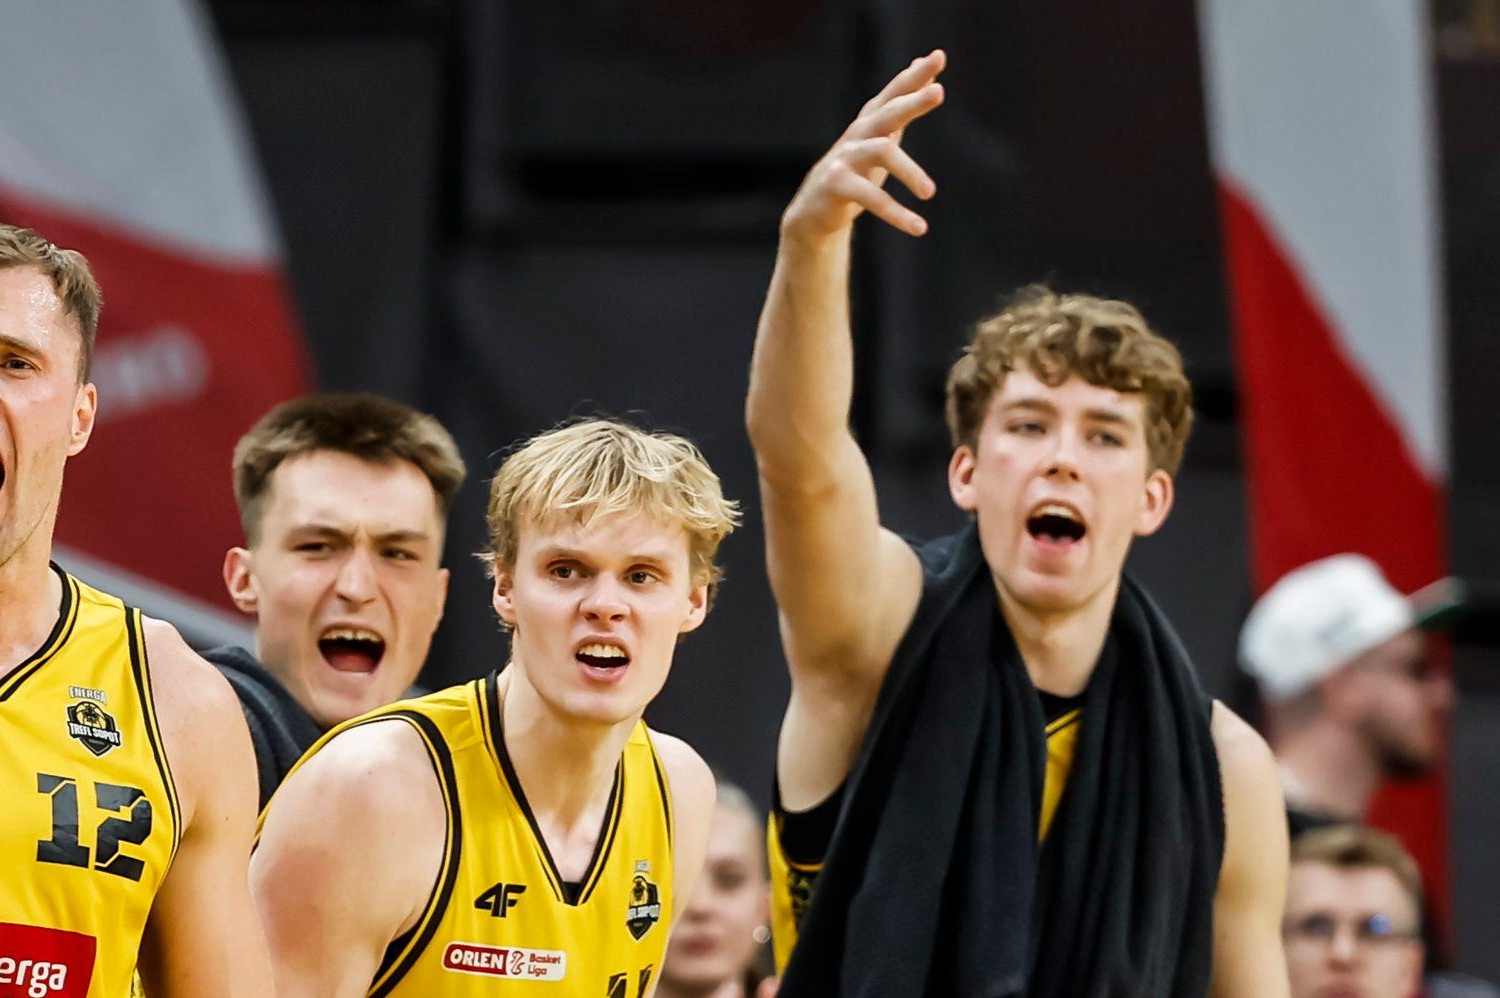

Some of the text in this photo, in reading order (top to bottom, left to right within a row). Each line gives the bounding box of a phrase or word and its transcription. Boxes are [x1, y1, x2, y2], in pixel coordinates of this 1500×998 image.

[69, 686, 107, 704] ENERGA
[69, 722, 120, 744] TREFL SOPOT
[36, 772, 153, 882] 12
[474, 882, 527, 918] 4F
[450, 948, 504, 970] ORLEN
[529, 953, 561, 964] Basket
[527, 965, 548, 977] Liga
